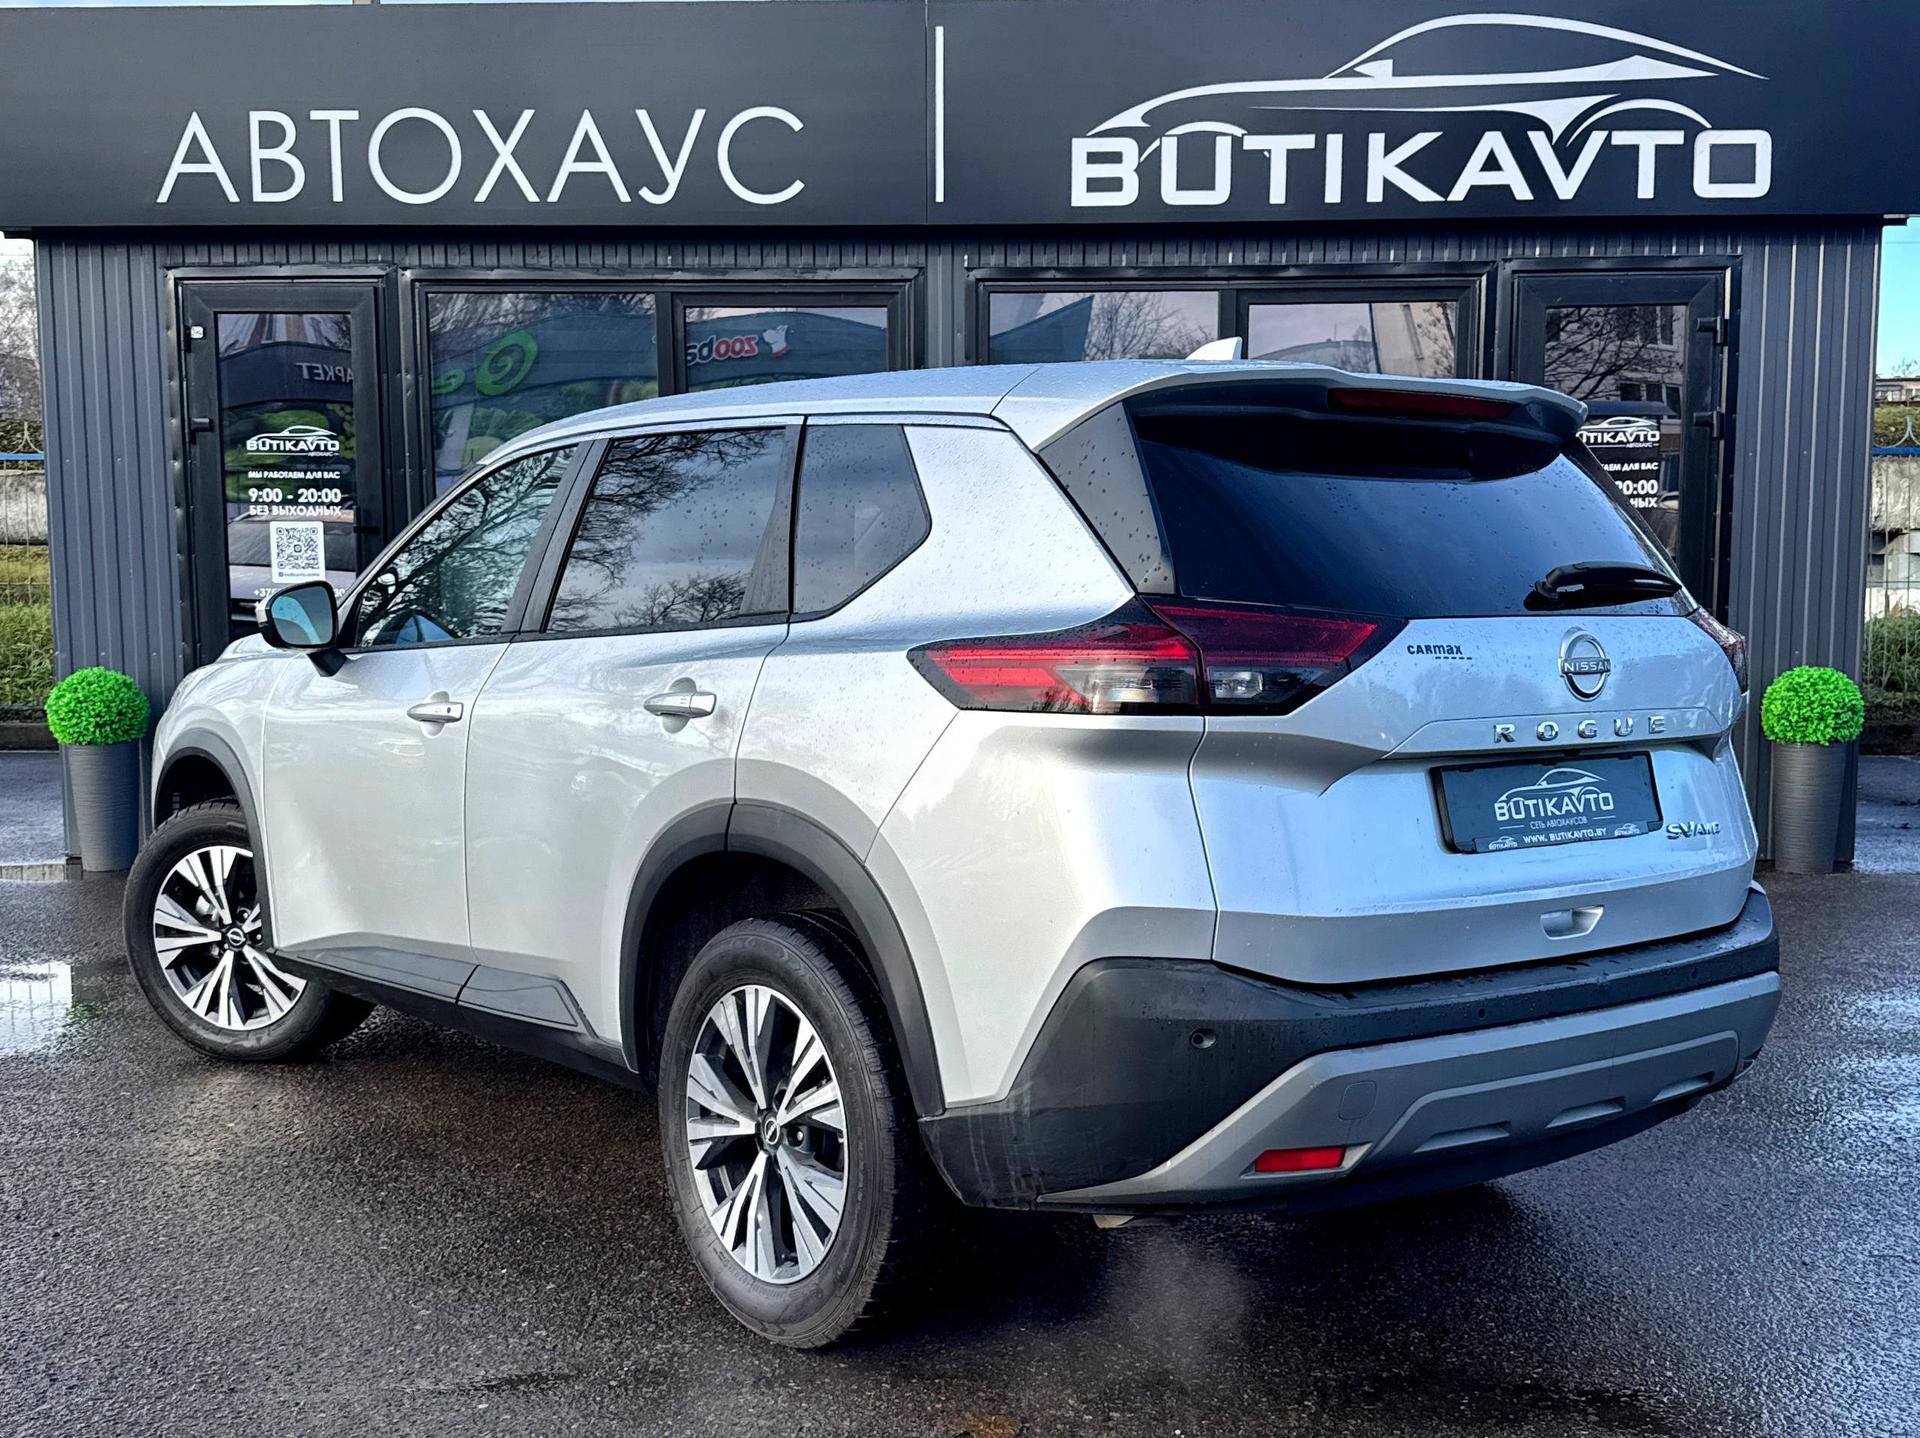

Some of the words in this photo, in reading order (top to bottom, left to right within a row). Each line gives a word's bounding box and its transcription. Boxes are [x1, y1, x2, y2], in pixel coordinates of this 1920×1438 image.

[156, 105, 805, 205] АВТОХАУС
[1071, 127, 1771, 207] BUTIKAVTO
[246, 439, 340, 451] BUTIKAVTO
[1641, 462, 1659, 471] ВАС
[248, 470, 263, 478] МЫ
[264, 470, 305, 478] РАБОТАЕМ
[305, 471, 323, 479] ДЛЯ
[323, 471, 341, 479] ВАС
[248, 488, 283, 503] 9:00
[297, 488, 342, 503] 20:00
[249, 505, 270, 516] БЕЗ
[272, 505, 342, 517] ВЫХОДНЫХ
[1564, 661, 1610, 672] NISSAN
[1494, 715, 1667, 744] ROGUE
[1494, 792, 1614, 821] BUTIKAVTO
[1523, 834, 1548, 844] WWW.
[1549, 828, 1607, 842] BUTIKAVTO.BY
